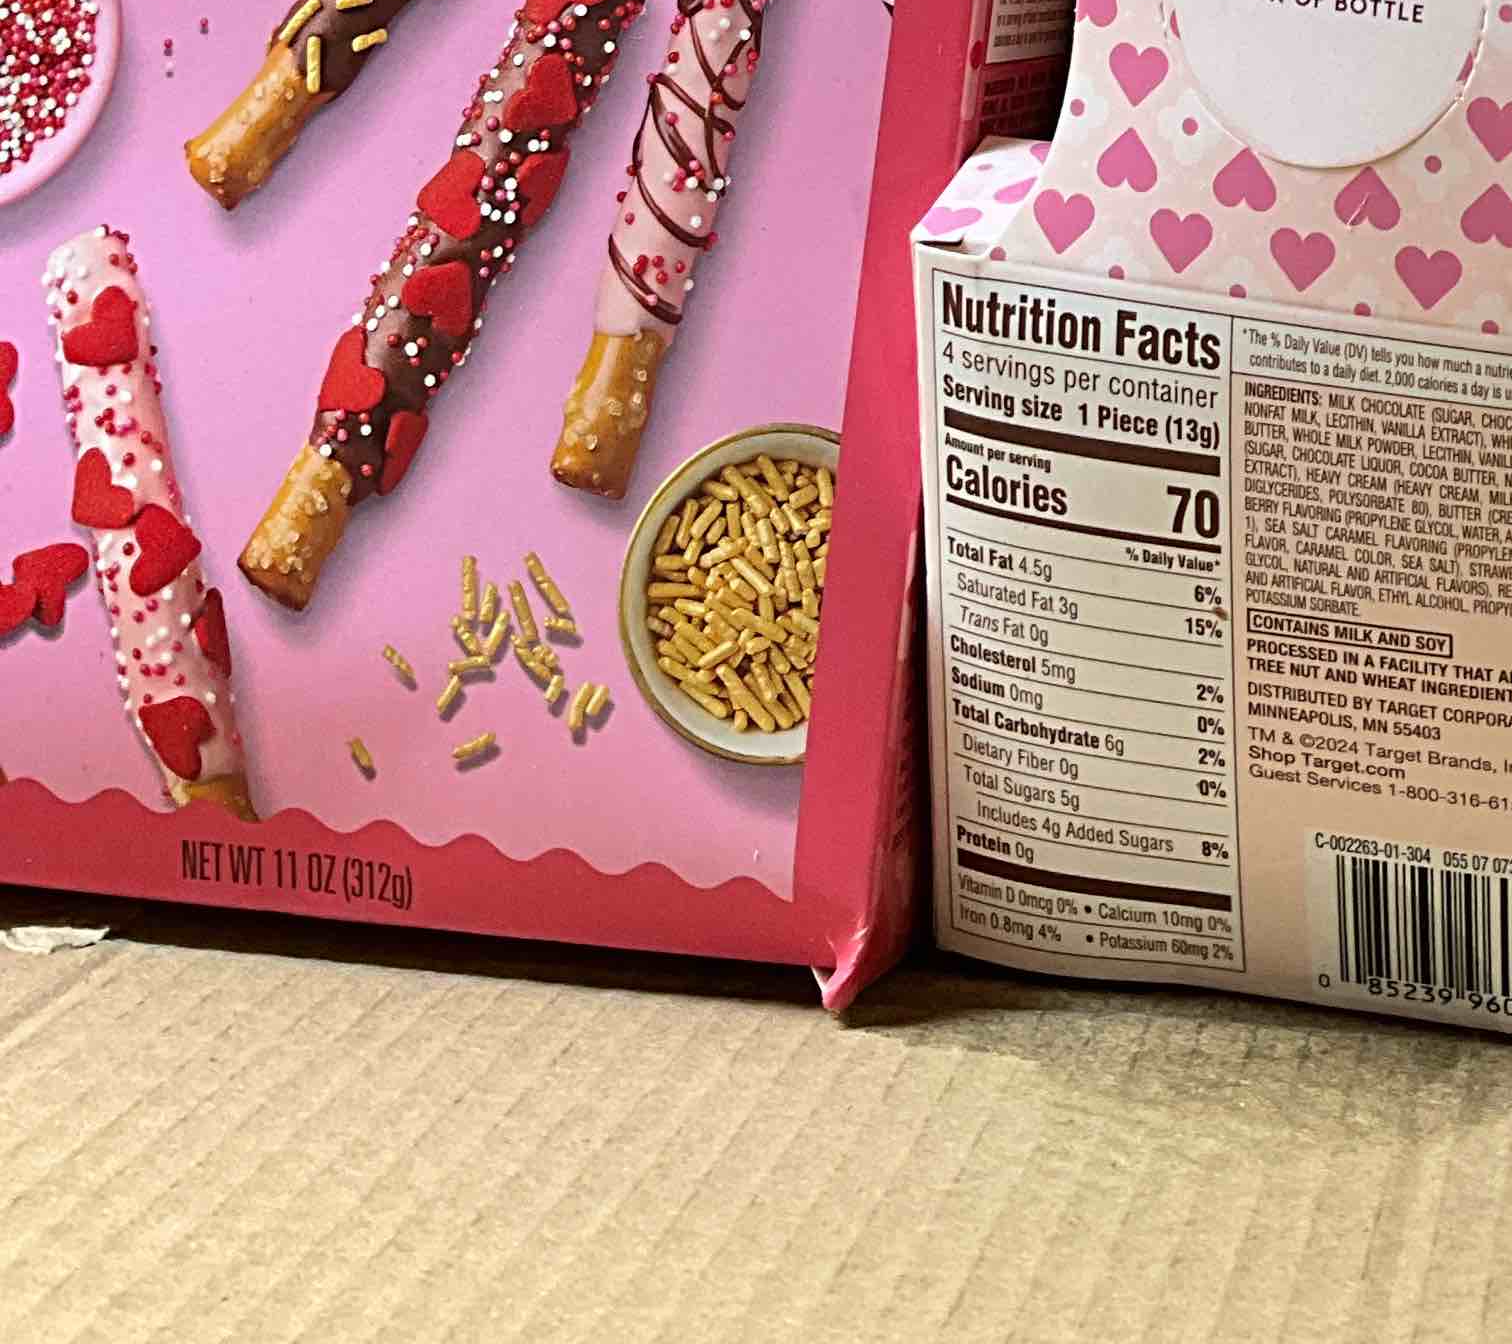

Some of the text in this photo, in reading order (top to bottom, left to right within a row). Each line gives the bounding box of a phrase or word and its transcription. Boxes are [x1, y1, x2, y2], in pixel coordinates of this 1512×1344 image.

[943, 281, 1220, 370] Nutrition Facts
[942, 341, 1219, 409] 4 servings per container
[944, 375, 1220, 450] Serving size 1 Piece (13g)
[947, 454, 1068, 515] Calories
[1167, 486, 1220, 539] 70
[948, 536, 1052, 582] Total Fat 4.5g
[957, 573, 1078, 620] Saturated Fat 3g
[1253, 615, 1446, 653] CONTAINS MILK AND SOY
[951, 634, 1076, 684] Cholesterol 5mg
[1247, 639, 1338, 663] PROCESSED
[1343, 651, 1359, 665] IN
[1364, 654, 1374, 667] A
[1380, 656, 1448, 678] FACILITY
[1454, 665, 1493, 682] THAT
[952, 666, 1043, 710] Sodium 0mg
[1248, 682, 1348, 709] DISTRIBUTED
[1353, 697, 1372, 712] BY
[1376, 700, 1438, 721] TARGET
[1248, 702, 1441, 741] MINNEAPOLIS, MN 55403
[1249, 763, 1301, 783] Guest
[1307, 771, 1382, 795] Services
[1315, 832, 1431, 863] C-002263-01-304
[1443, 851, 1468, 869] 055
[1472, 855, 1488, 871] 07
[182, 840, 413, 910] NET WT 11 OZ (312g)
[1318, 974, 1330, 988] 0
[1368, 977, 1451, 1005] 85239
